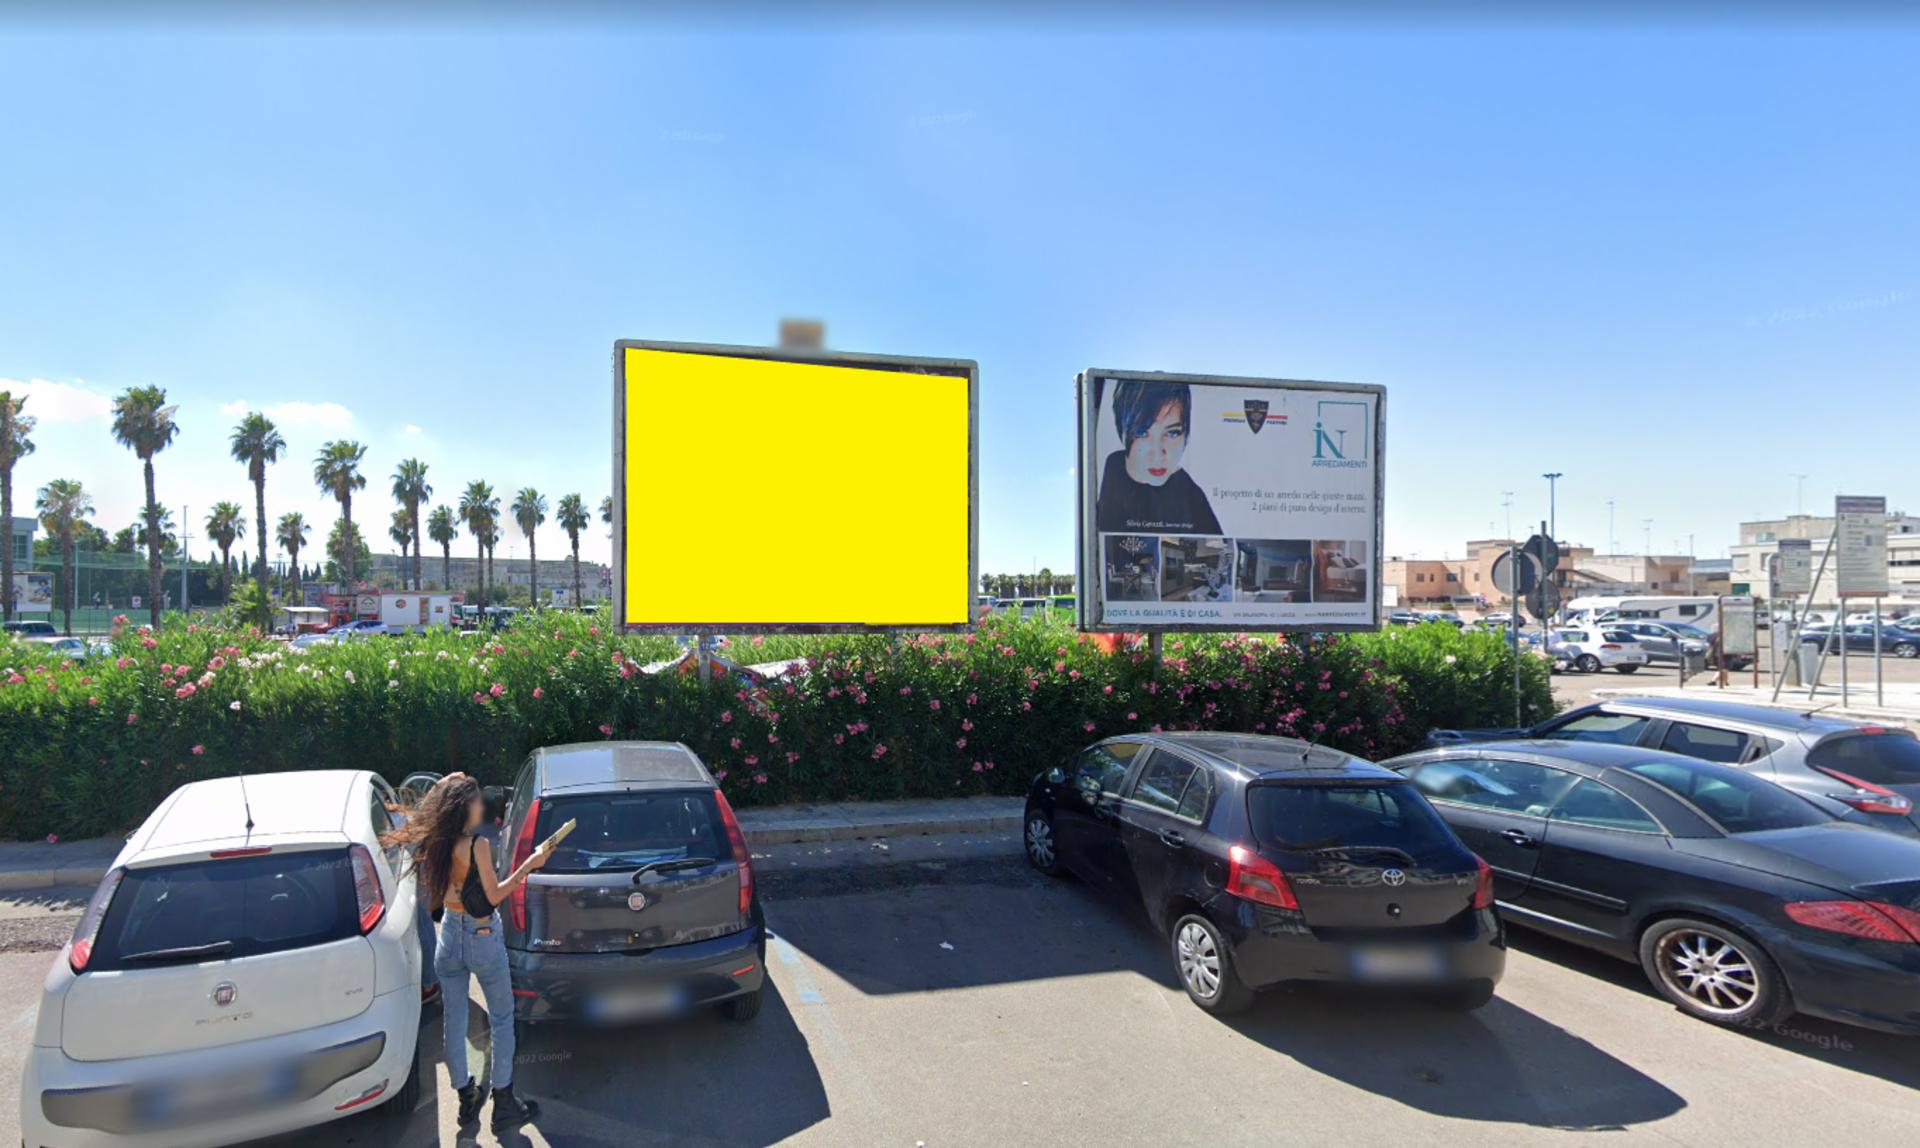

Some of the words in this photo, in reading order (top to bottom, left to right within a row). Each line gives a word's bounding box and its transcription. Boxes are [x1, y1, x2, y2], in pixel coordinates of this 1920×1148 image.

[1311, 459, 1368, 469] ARREDAMENTI
[1220, 489, 1253, 501] progetto
[1254, 488, 1263, 498] di
[1251, 502, 1257, 511] 2
[1258, 502, 1278, 513] piani
[1280, 502, 1287, 512] di
[1106, 609, 1127, 617] DOVE
[1129, 609, 1140, 617] LA
[1187, 609, 1197, 618] DI
[533, 938, 562, 947] Punto
